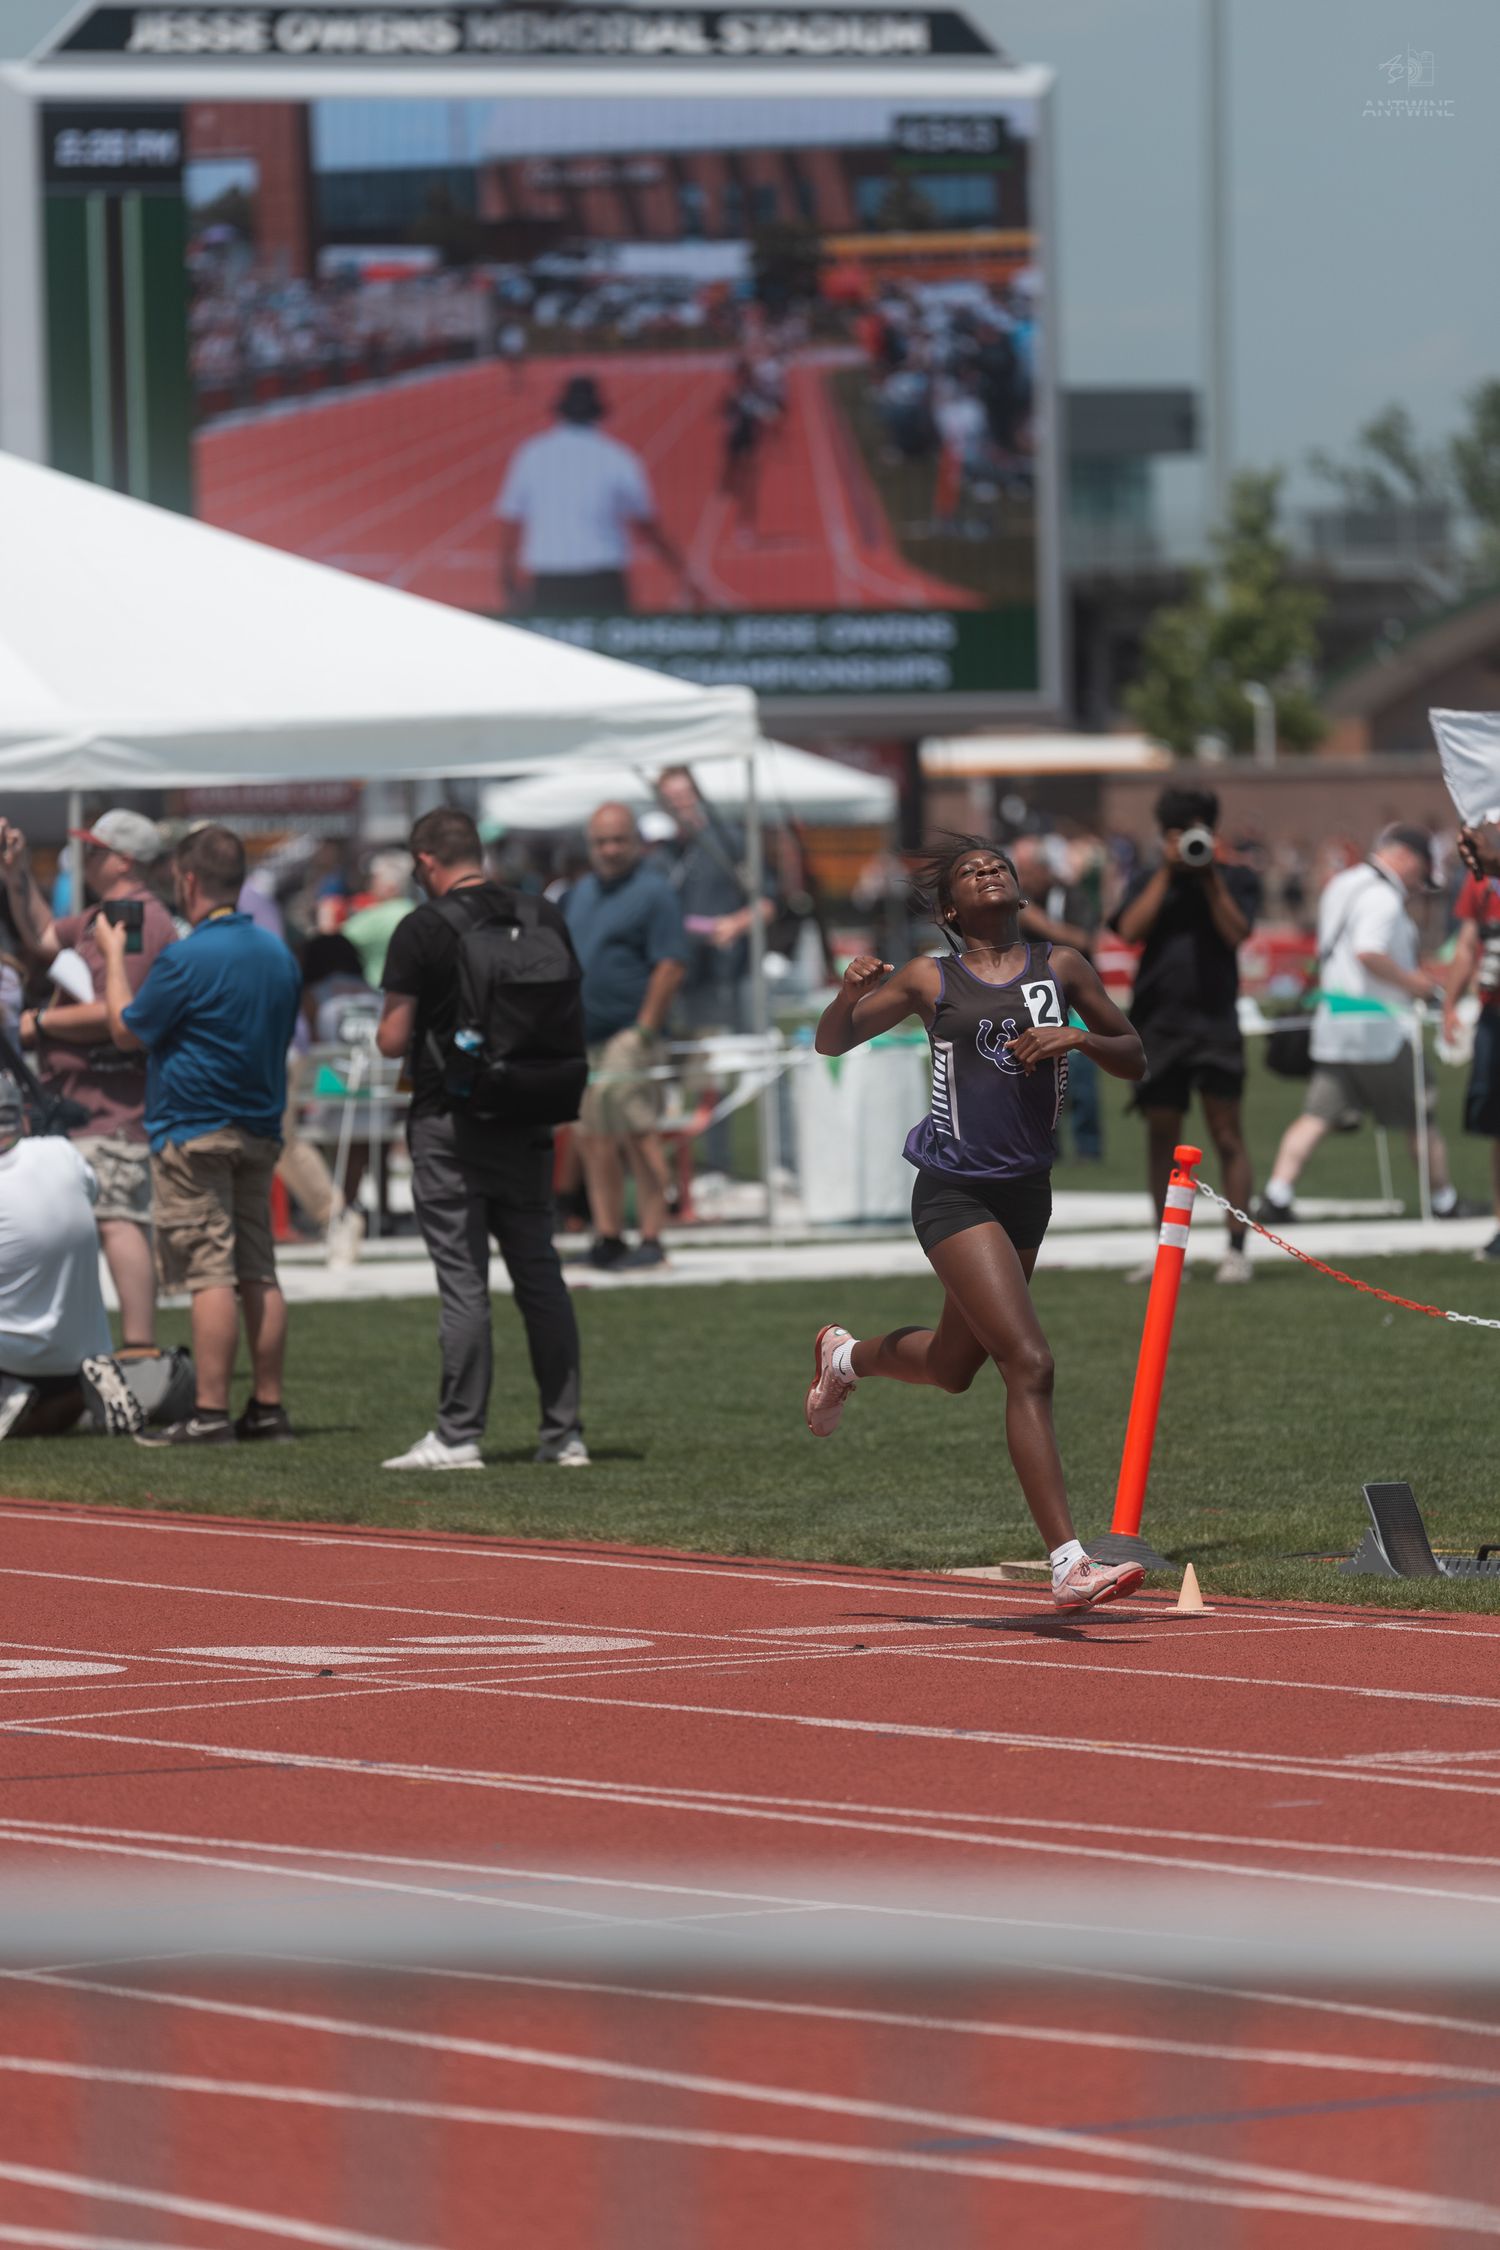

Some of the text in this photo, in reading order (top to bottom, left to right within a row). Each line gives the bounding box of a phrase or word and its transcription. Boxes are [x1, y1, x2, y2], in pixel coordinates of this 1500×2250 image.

[126, 12, 931, 54] JESSE OWENS MEMORIAL STADIUM
[732, 614, 818, 650] JESSE
[822, 613, 955, 649] OWENS
[1028, 984, 1059, 1025] 2
